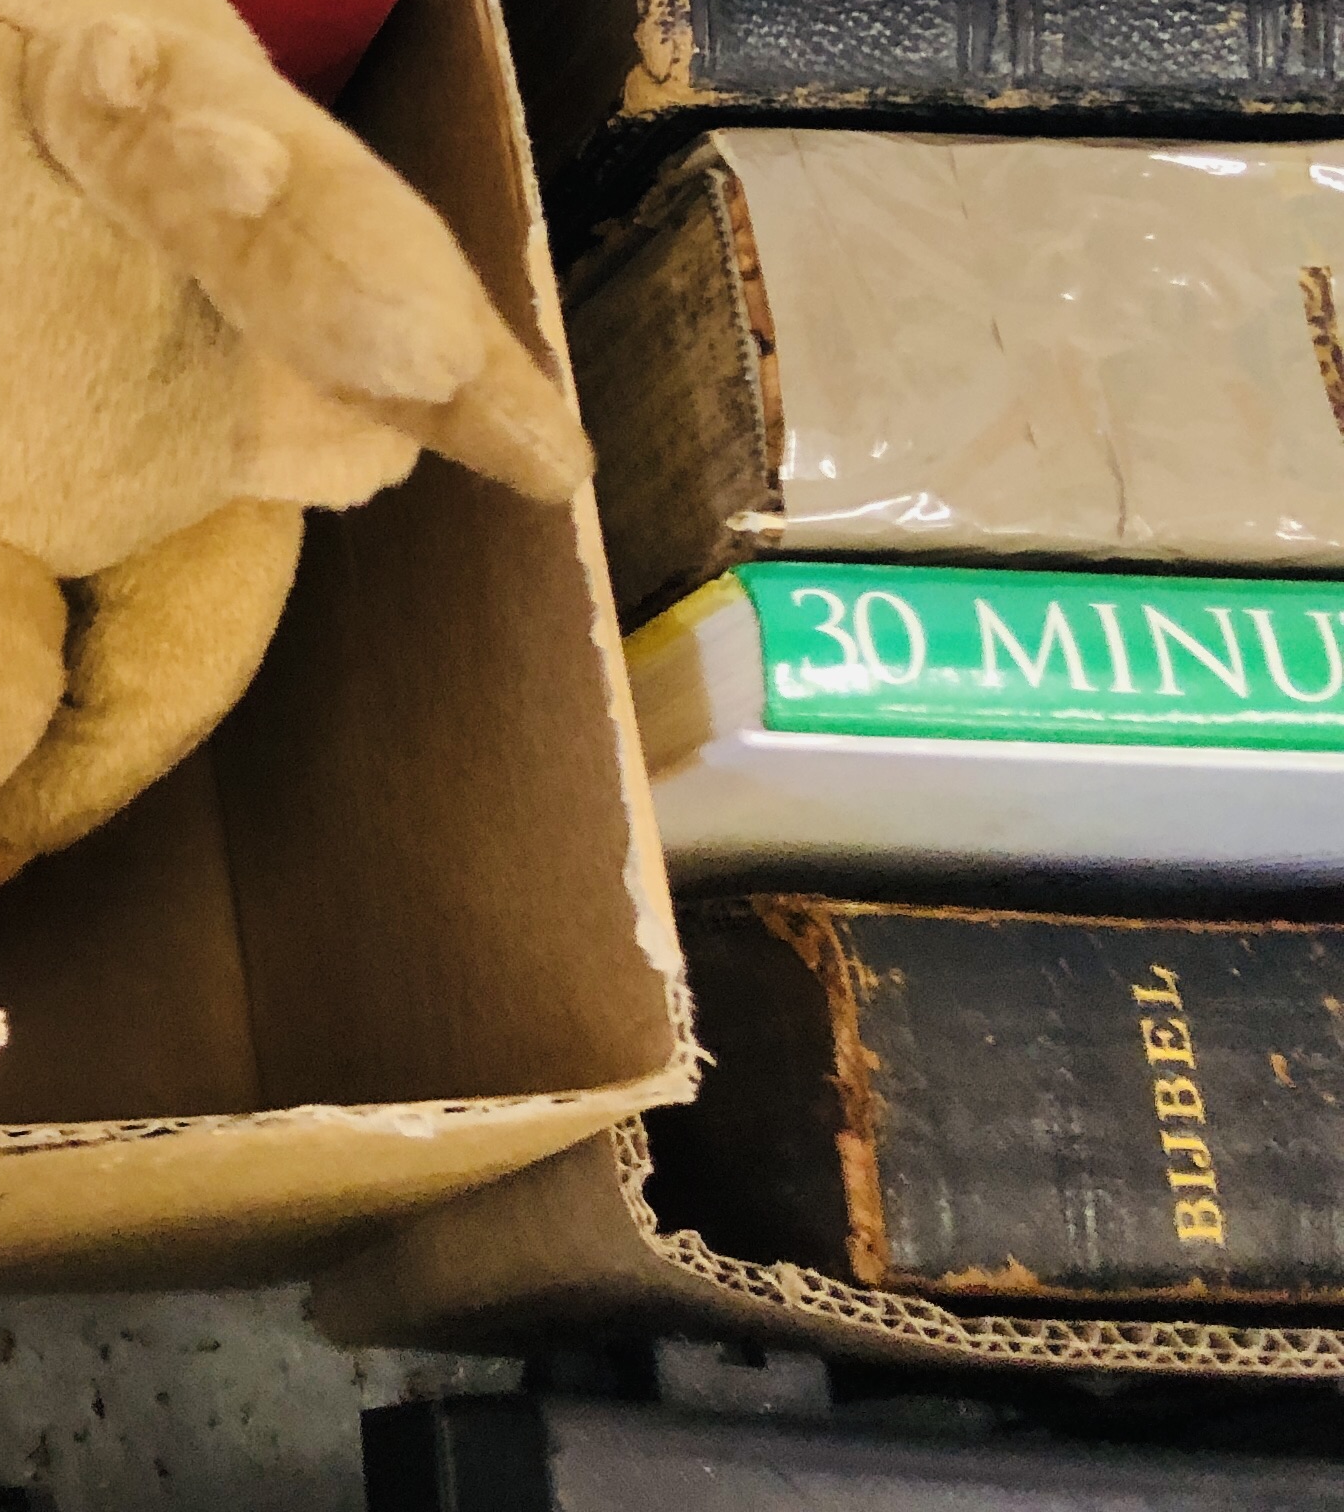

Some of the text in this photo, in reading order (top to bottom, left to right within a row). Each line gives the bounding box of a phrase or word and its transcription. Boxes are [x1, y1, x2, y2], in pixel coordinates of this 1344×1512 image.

[791, 587, 1344, 703] 30 MINU
[1131, 963, 1227, 1247] BIJBEL
